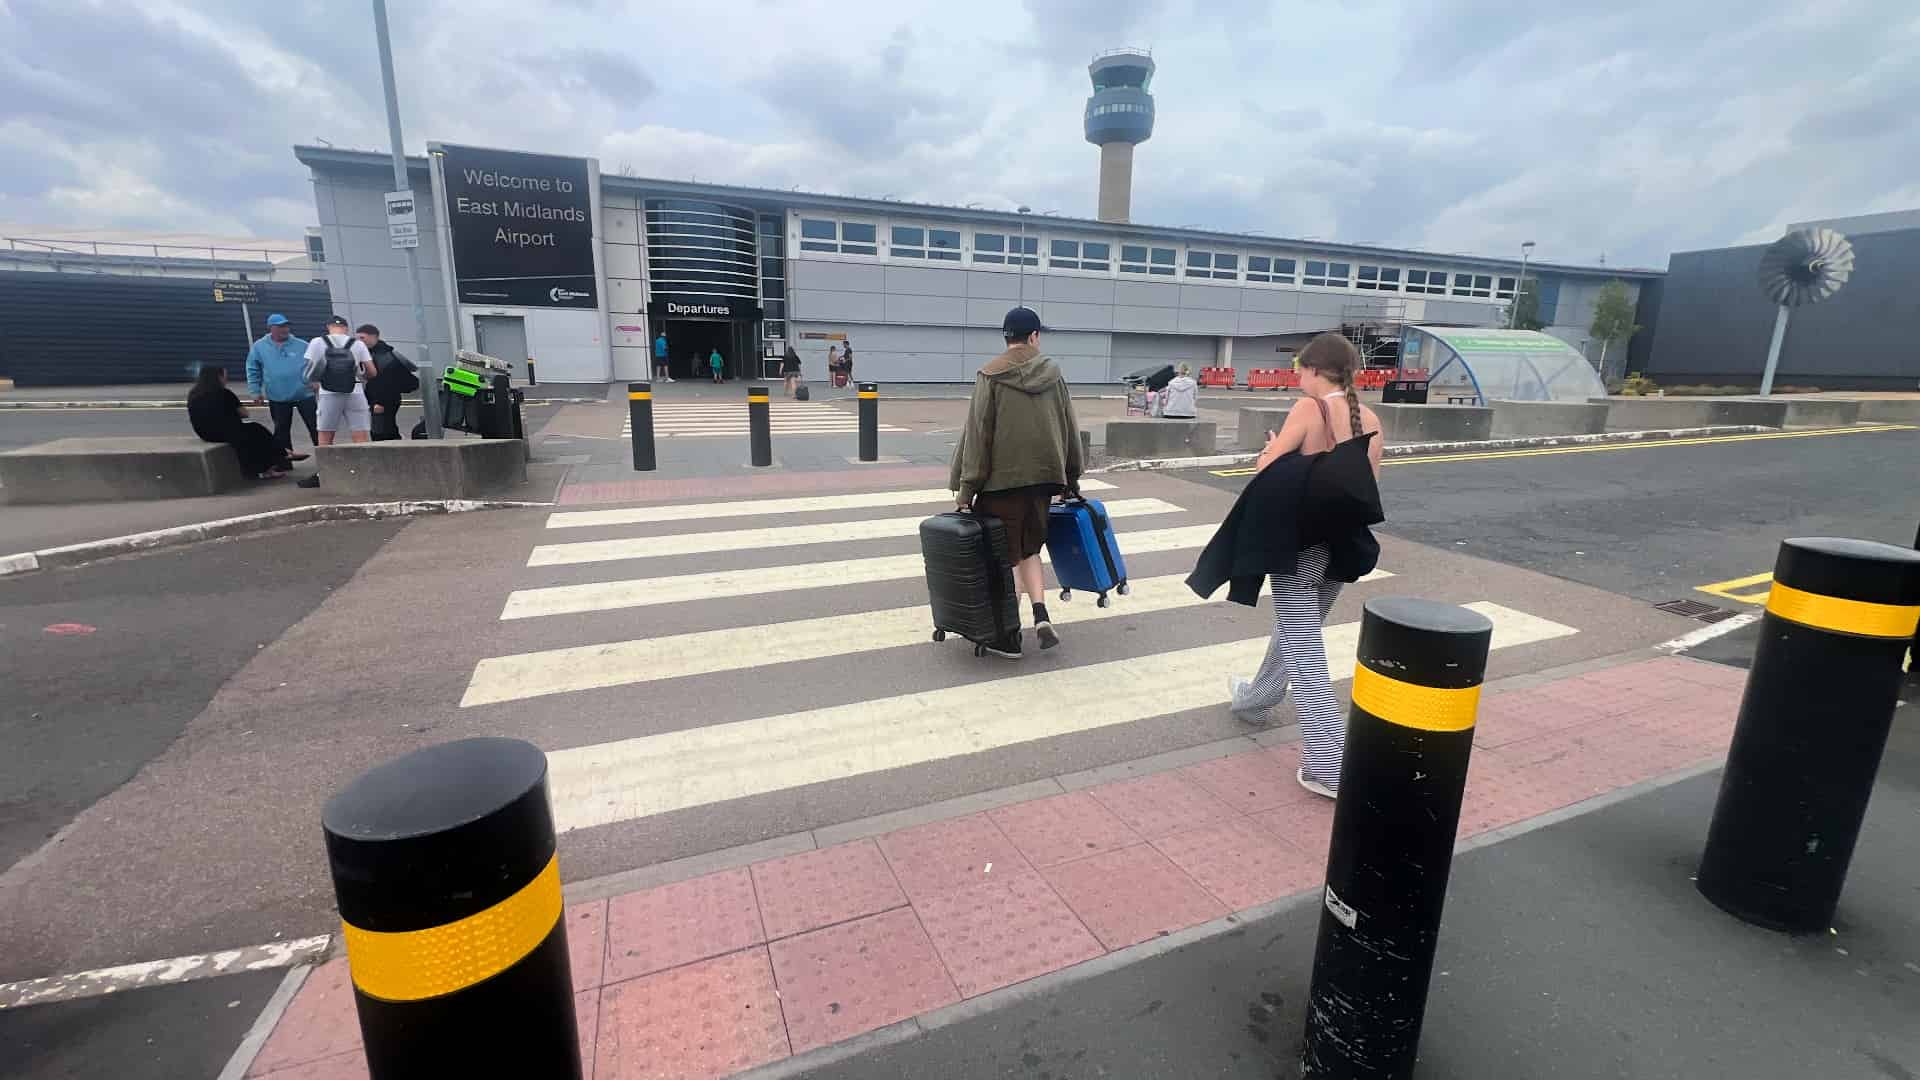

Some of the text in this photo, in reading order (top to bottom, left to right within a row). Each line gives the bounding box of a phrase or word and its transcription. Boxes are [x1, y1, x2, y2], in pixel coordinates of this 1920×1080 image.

[464, 168, 573, 193] Welcome to
[456, 197, 585, 222] East Midlands
[495, 227, 555, 248] Airport
[667, 302, 730, 316] Departures
